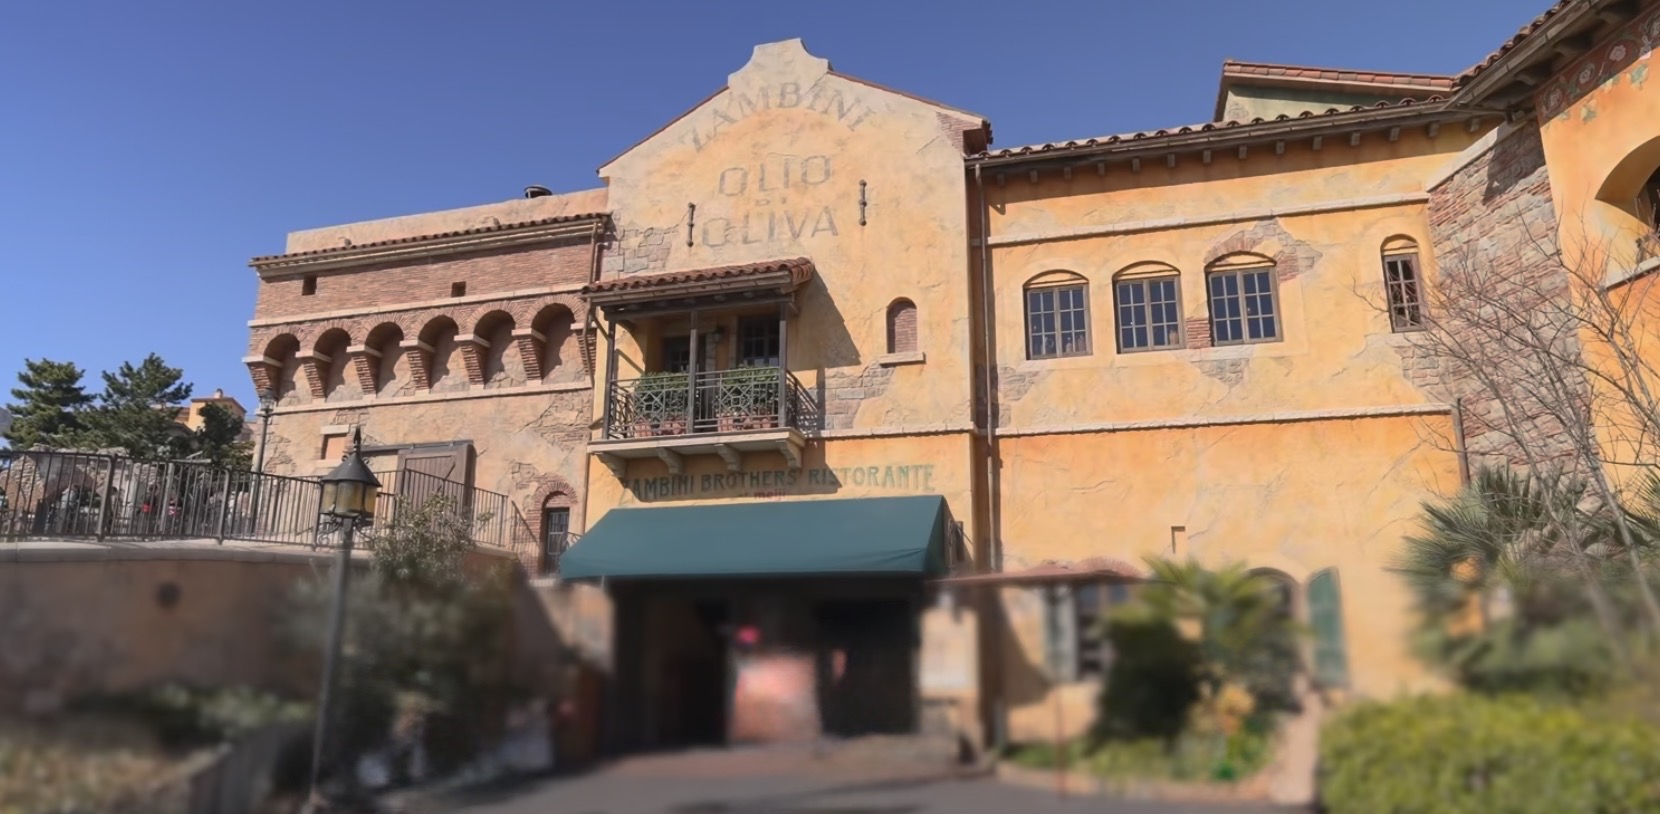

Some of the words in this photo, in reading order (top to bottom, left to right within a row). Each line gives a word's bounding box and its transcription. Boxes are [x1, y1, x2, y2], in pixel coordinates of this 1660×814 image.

[678, 81, 875, 153] ZAMBINI
[719, 155, 831, 197] OLIO
[702, 206, 839, 248] OLIVA
[754, 488, 786, 501] meiji
[808, 464, 936, 491] RISTORANTE
